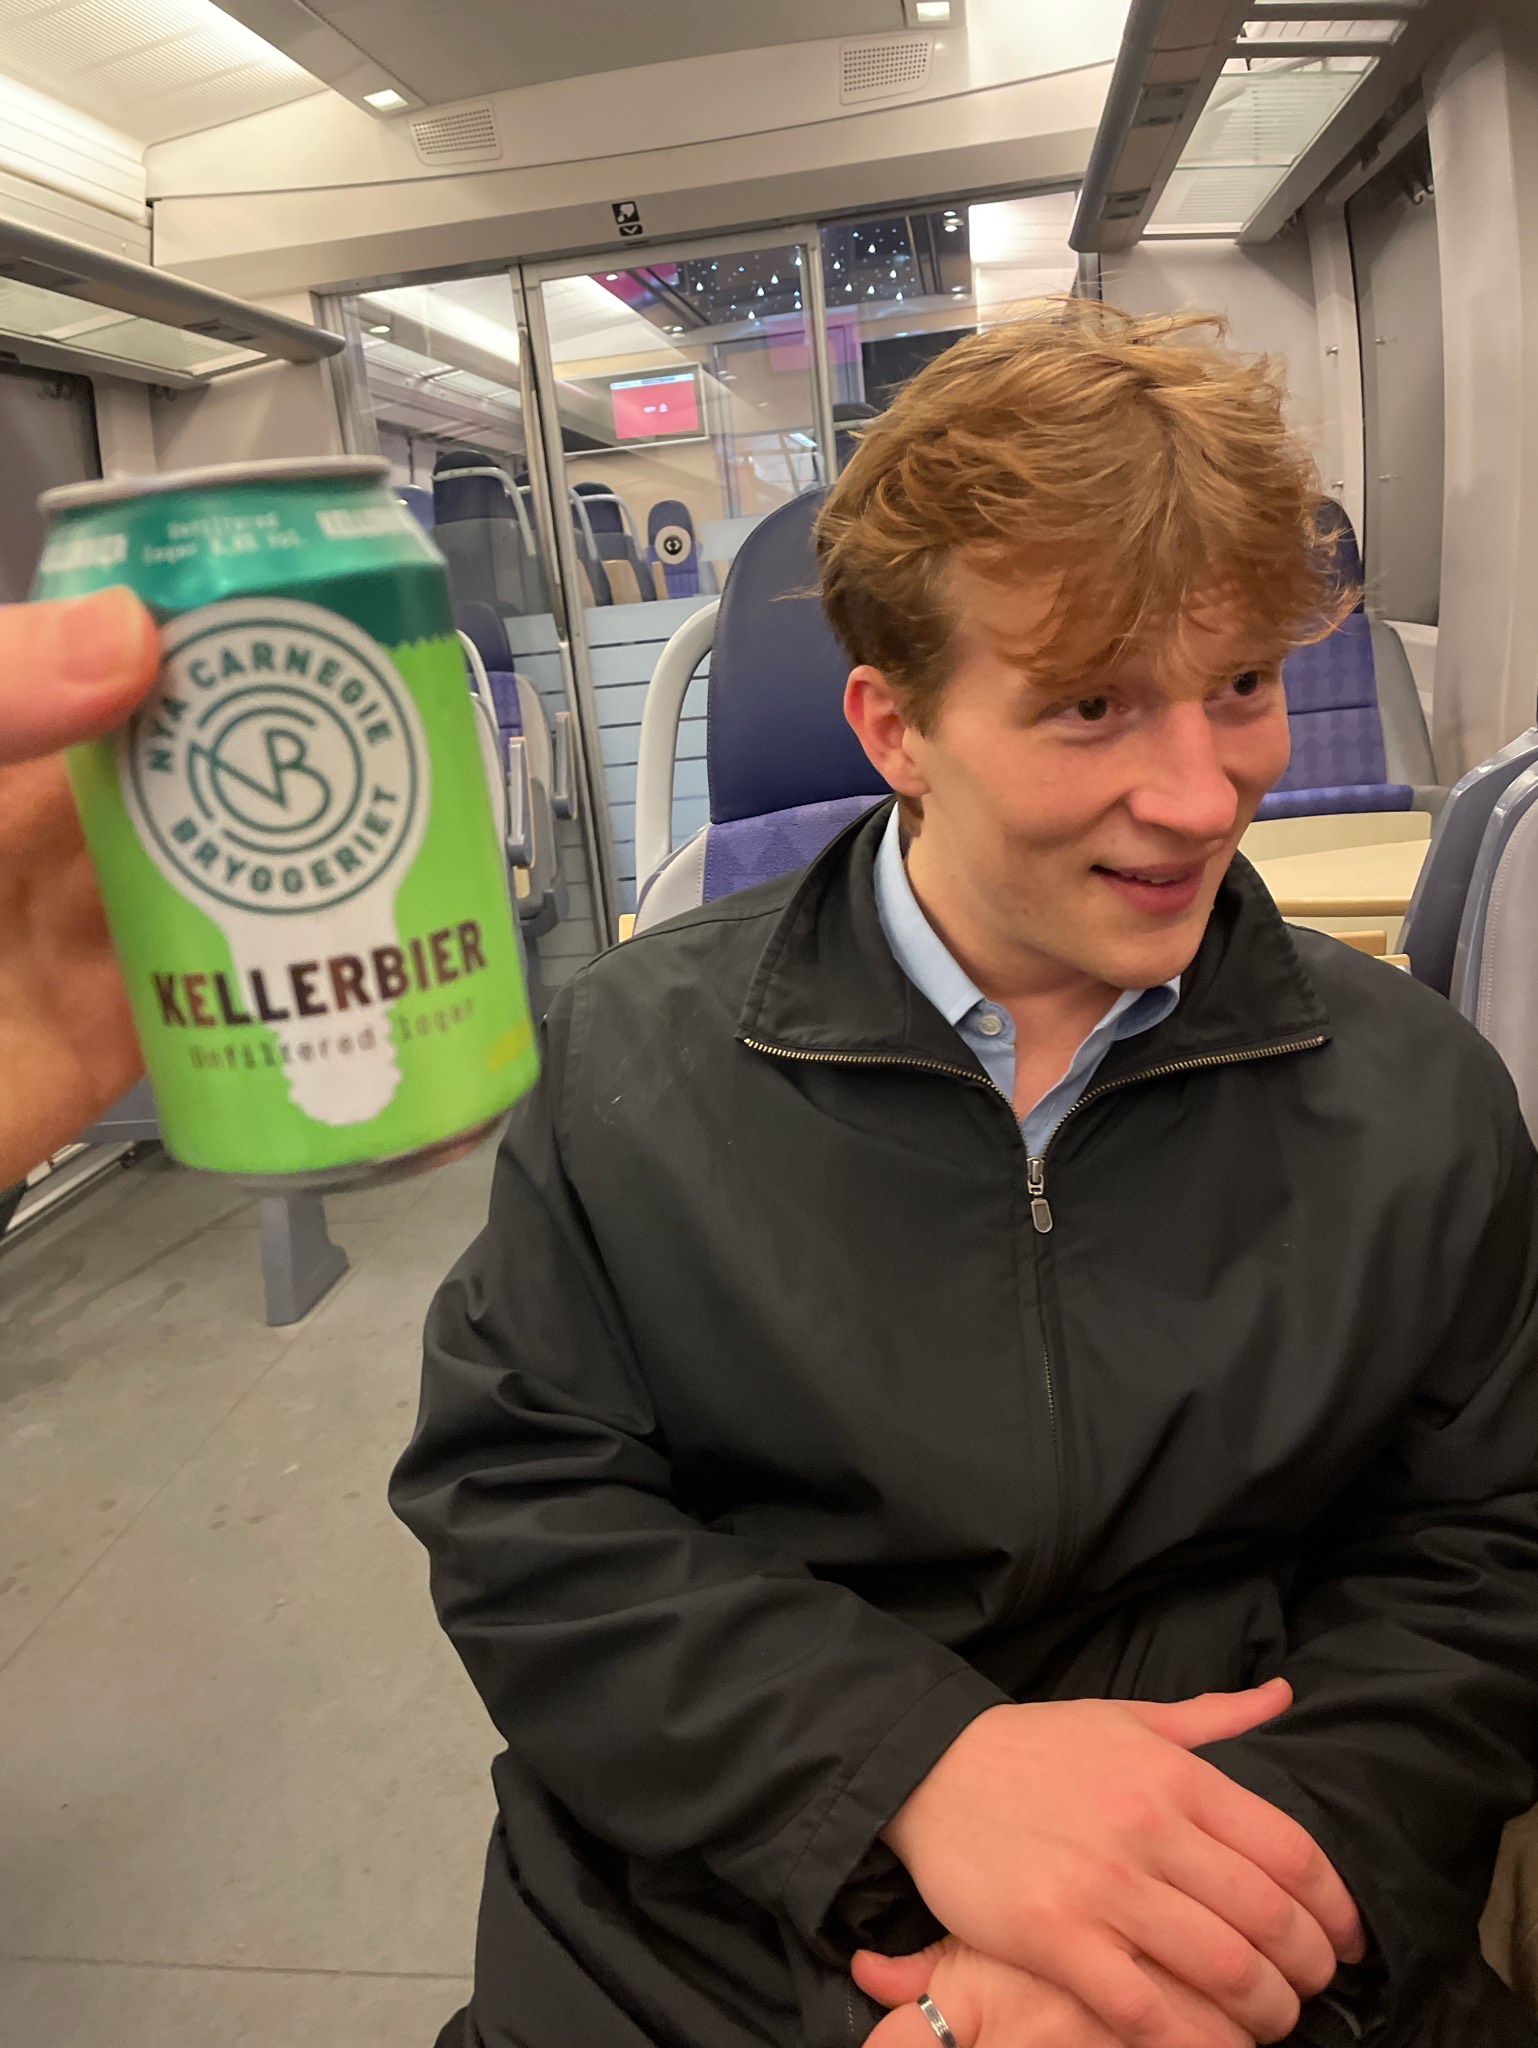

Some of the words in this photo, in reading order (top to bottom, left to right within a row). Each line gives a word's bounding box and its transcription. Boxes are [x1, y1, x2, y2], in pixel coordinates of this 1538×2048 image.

[149, 697, 190, 774] NYA
[187, 640, 393, 744] CARNEGIE
[172, 785, 398, 895] BRYGGERIET
[151, 918, 488, 1028] KELLERBIER
[189, 1025, 378, 1071] Unfiltered
